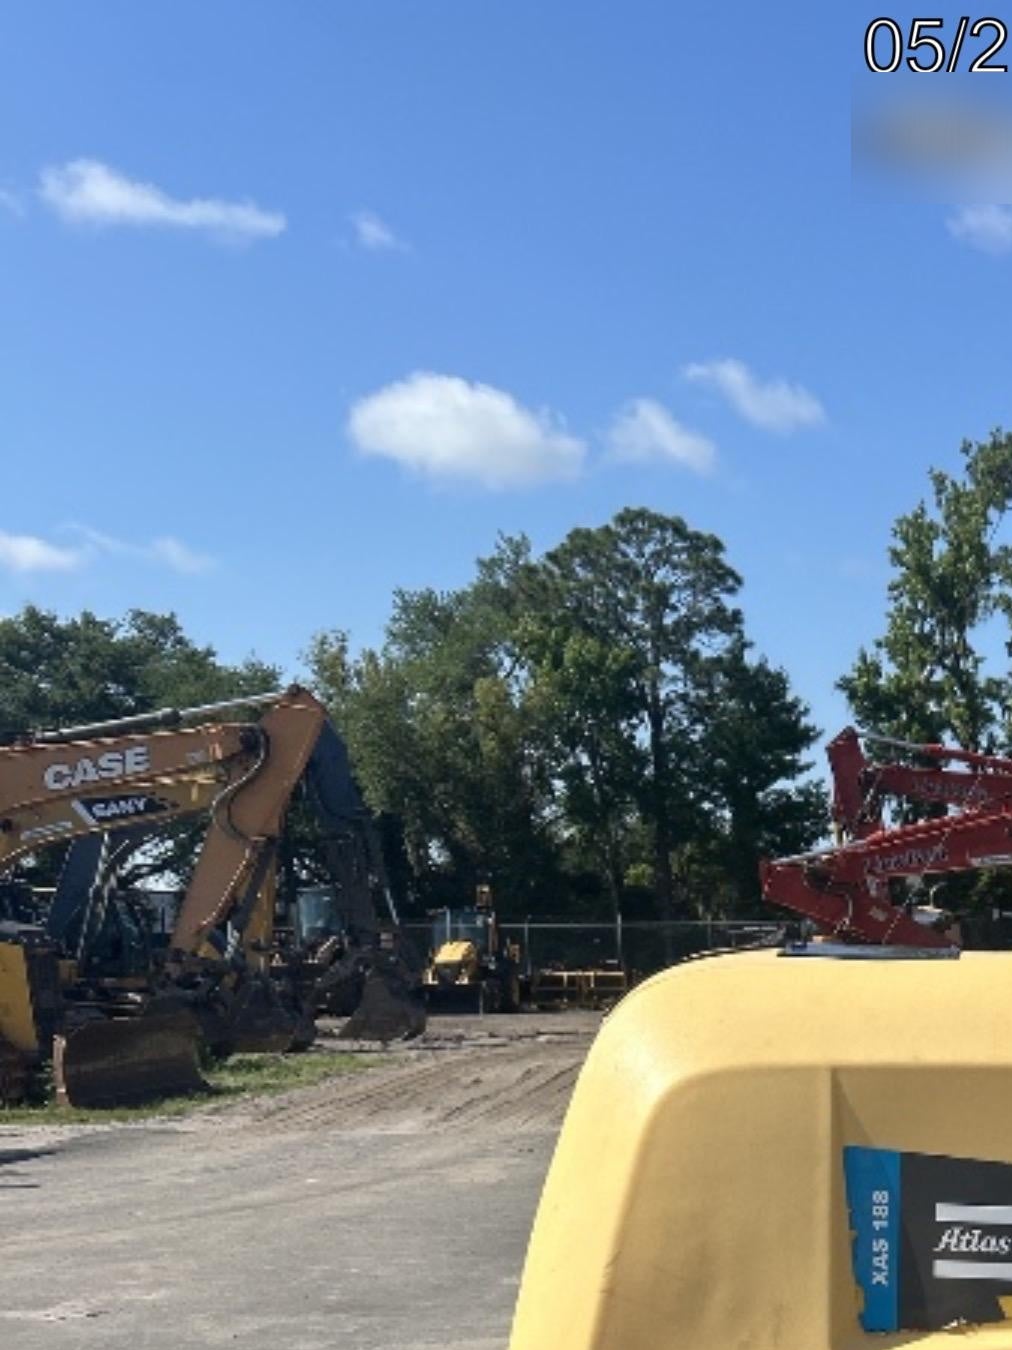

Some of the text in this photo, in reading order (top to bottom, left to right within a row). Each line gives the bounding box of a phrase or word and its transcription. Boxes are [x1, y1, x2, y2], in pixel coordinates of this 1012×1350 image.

[44, 746, 148, 790] CASE
[92, 797, 147, 818] SANY
[872, 1190, 889, 1287] XAS 188
[933, 1227, 1010, 1255] Atlas
